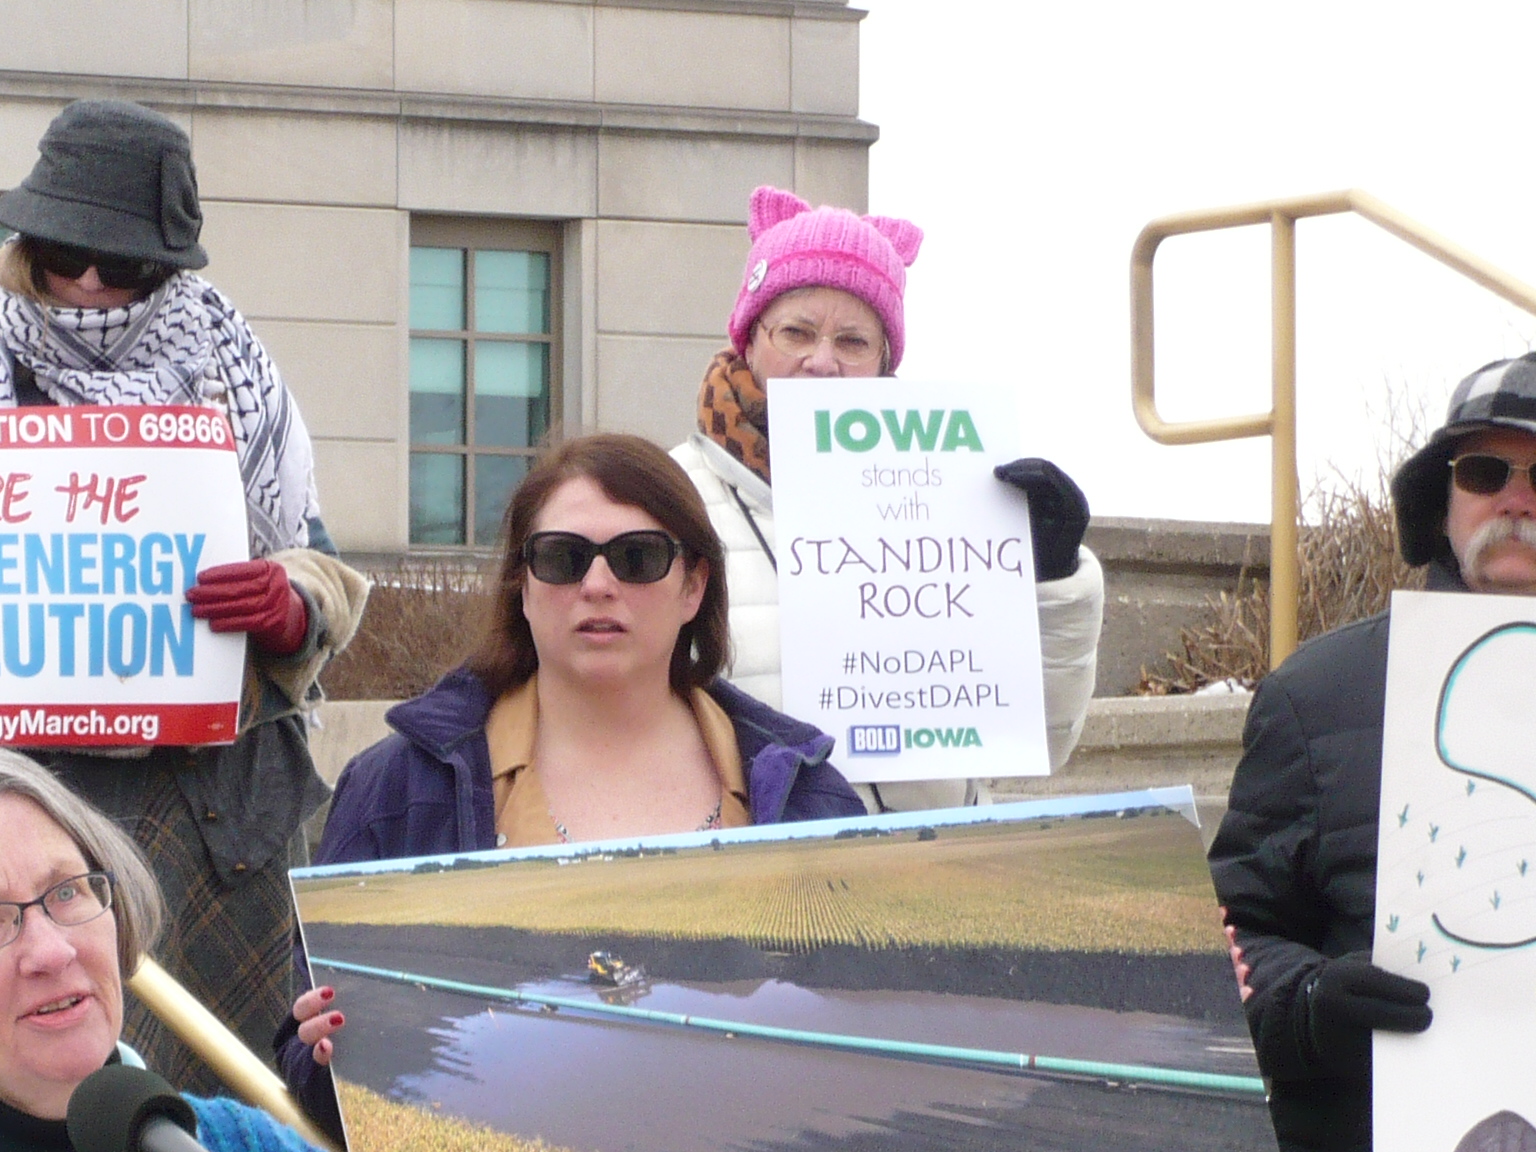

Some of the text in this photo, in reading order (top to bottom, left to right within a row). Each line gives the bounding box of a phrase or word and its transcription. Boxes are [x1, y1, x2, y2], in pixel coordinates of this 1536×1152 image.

[81, 412, 130, 443] TO
[138, 412, 227, 445] 69866
[814, 409, 985, 453] IOWA
[861, 456, 943, 488] stands
[876, 491, 930, 521] with
[789, 536, 1024, 578] STANDING
[857, 581, 975, 620] ROCK
[842, 649, 984, 675] #NoDAPL
[818, 683, 1010, 711] #DivestDAPL
[854, 726, 984, 752] BOLD IOWA
